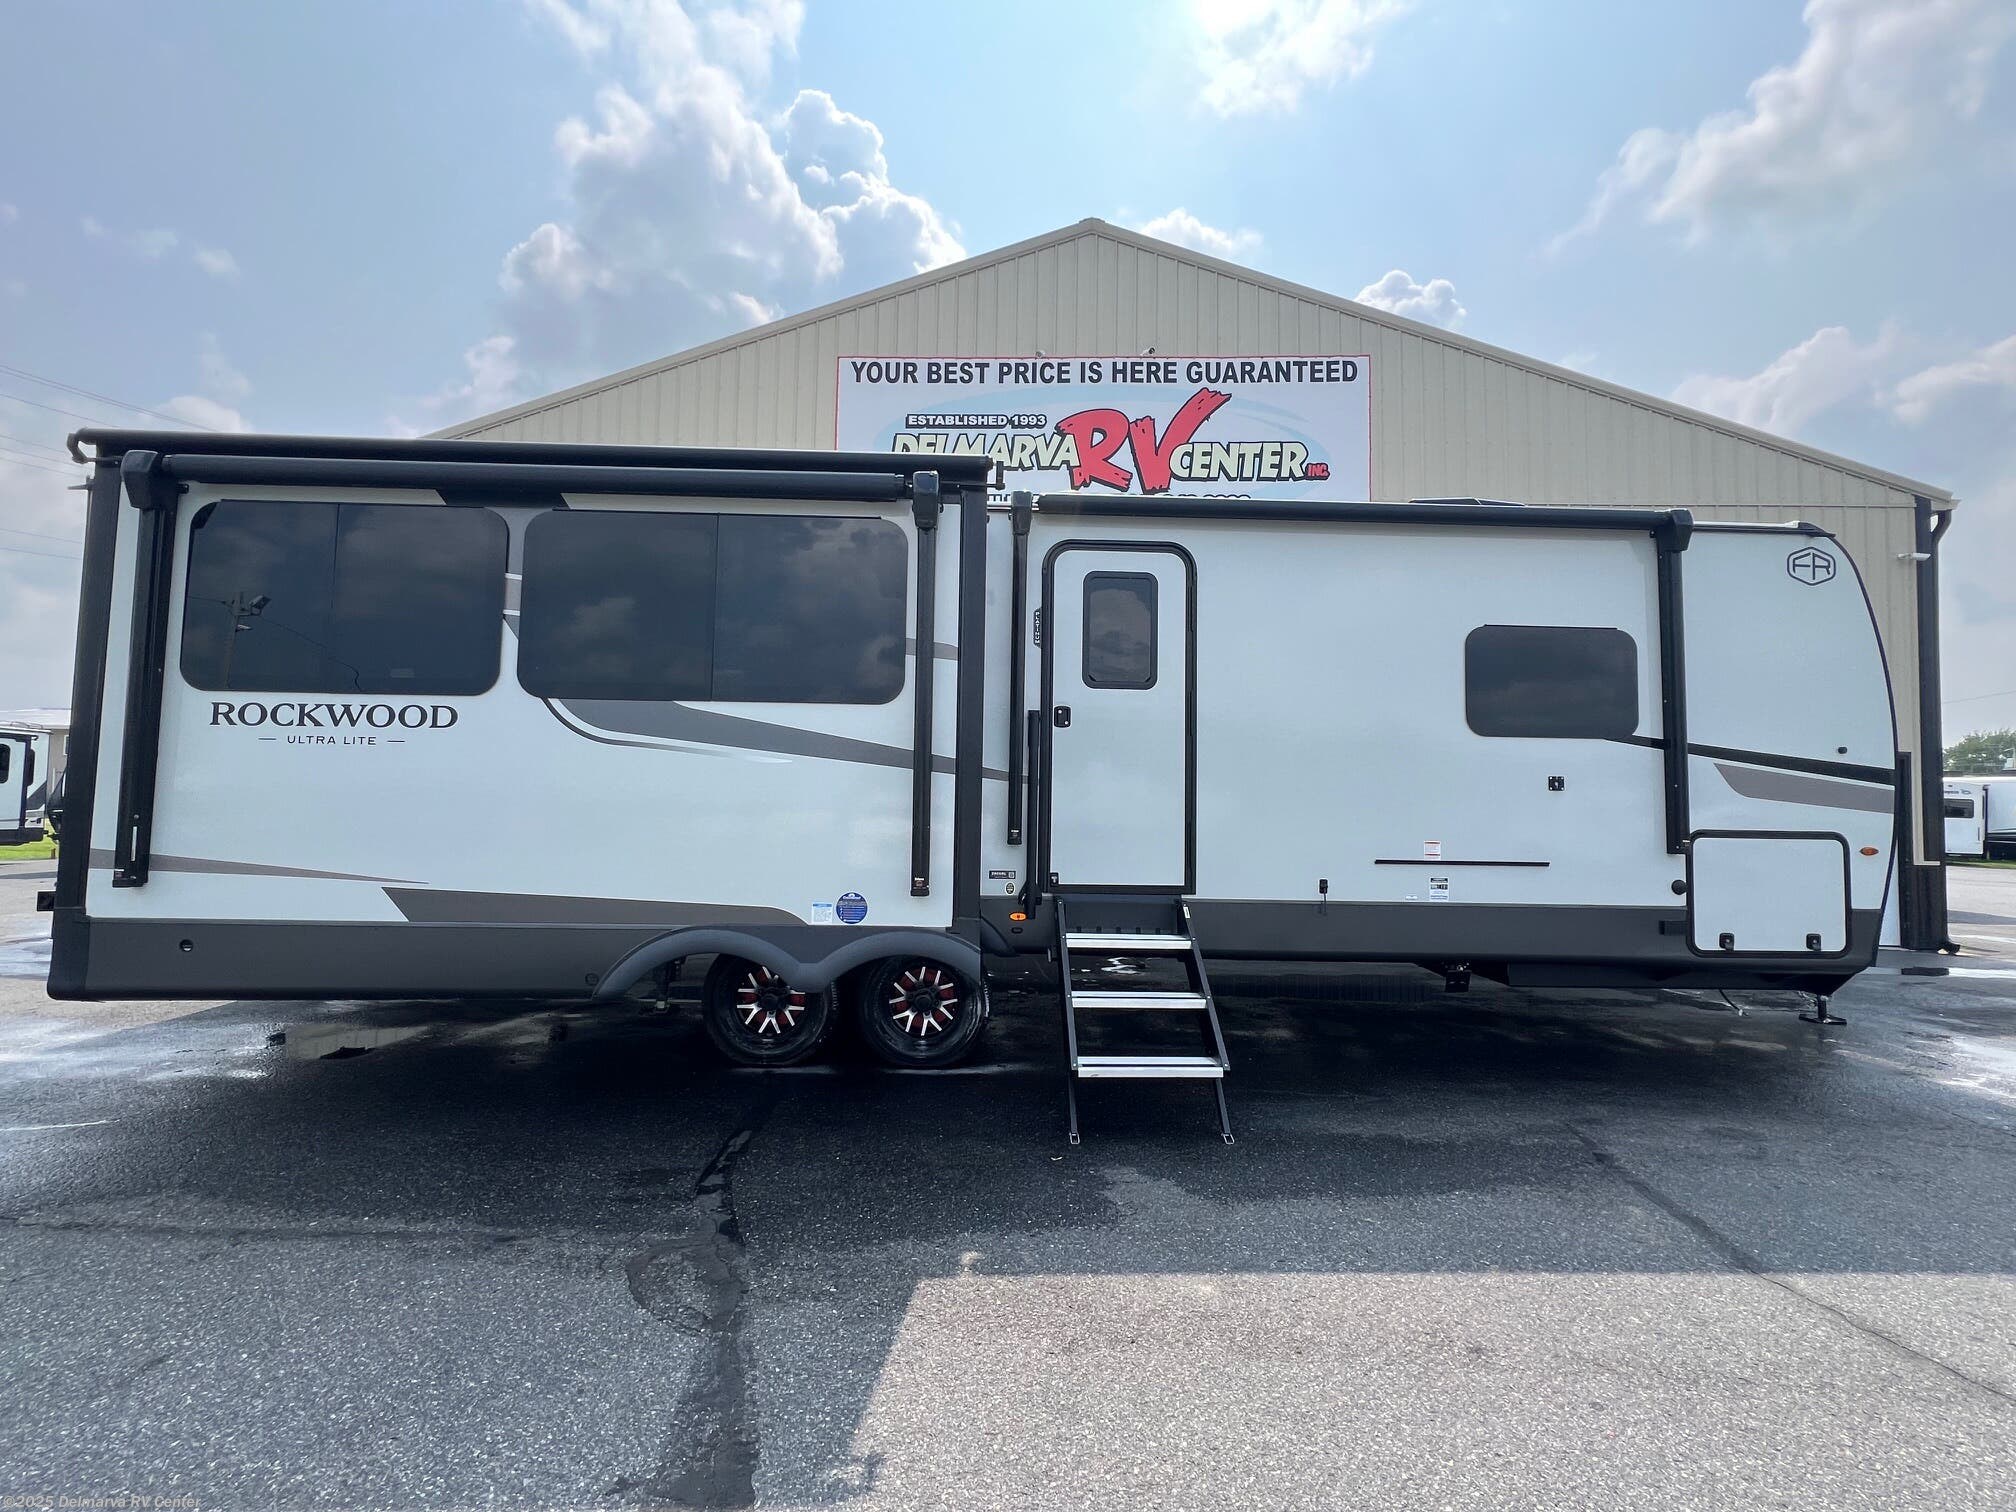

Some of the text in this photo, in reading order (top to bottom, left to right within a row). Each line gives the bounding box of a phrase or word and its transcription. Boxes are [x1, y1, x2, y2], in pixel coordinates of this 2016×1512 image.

[851, 360, 1358, 384] YOUR BEST PRICE IS HERE GUARANTEED
[908, 415, 1047, 427] ESTABLISHED 1993
[1054, 388, 1232, 490] RV
[1169, 442, 1308, 480] CENTER
[209, 702, 459, 729] ROCKWOOD
[286, 735, 377, 746] ULTRA LITE
